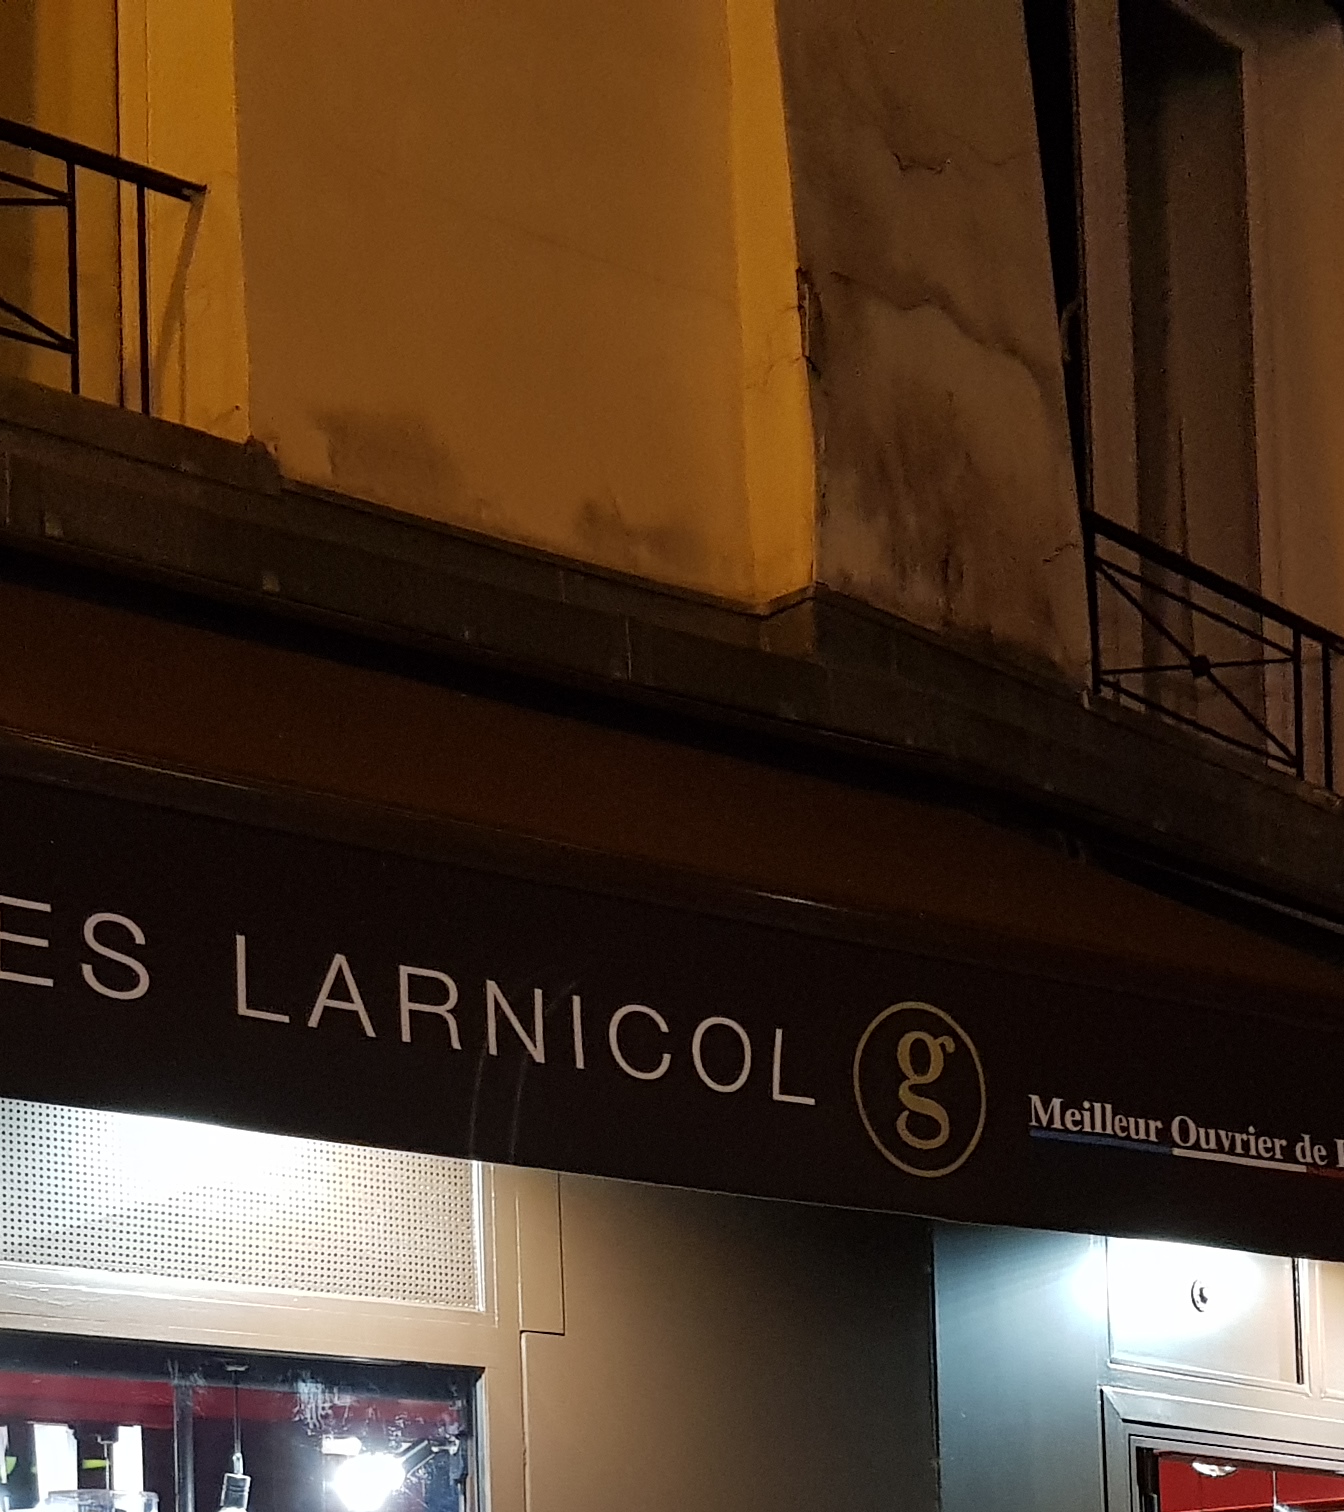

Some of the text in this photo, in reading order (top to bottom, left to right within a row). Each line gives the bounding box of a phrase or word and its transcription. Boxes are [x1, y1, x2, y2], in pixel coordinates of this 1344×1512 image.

[235, 934, 816, 1106] LARNICOL
[1028, 1094, 1163, 1142] Meilleur
[1171, 1115, 1287, 1160] Ouvrier
[1295, 1133, 1328, 1166] de
